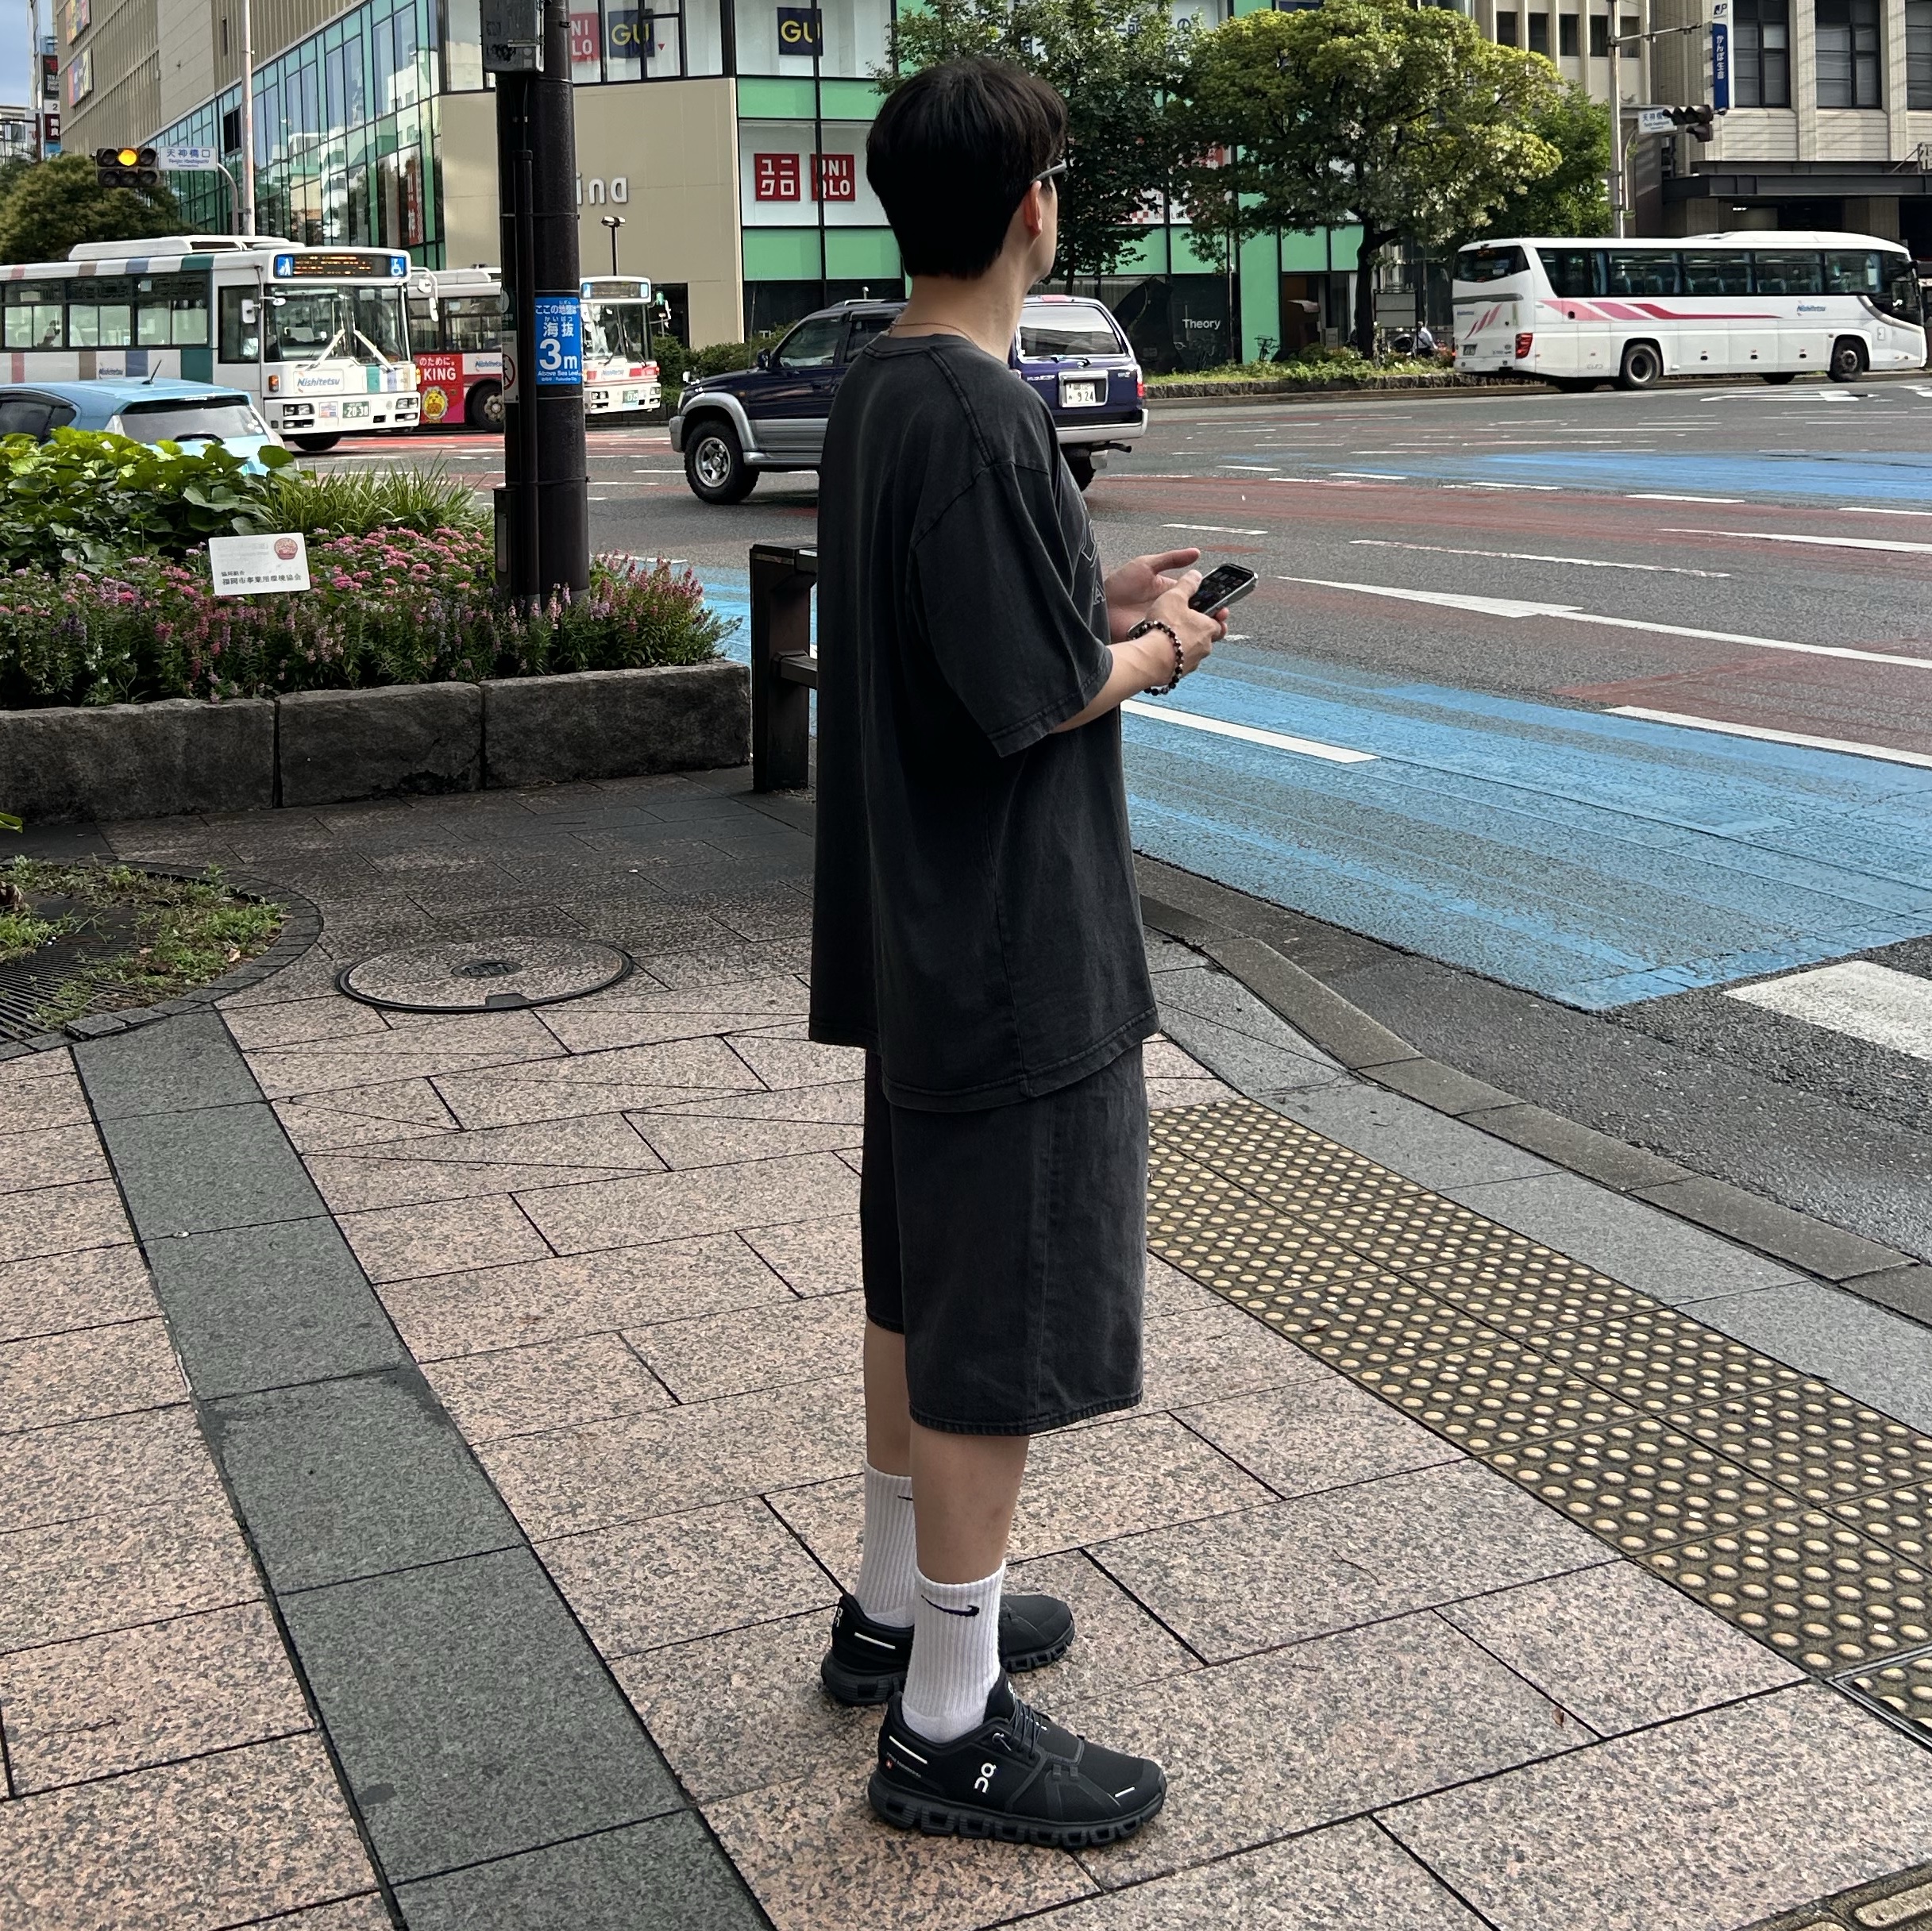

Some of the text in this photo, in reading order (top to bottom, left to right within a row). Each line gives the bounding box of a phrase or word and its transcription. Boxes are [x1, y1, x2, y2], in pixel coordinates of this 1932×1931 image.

[570, 20, 589, 37] NI
[611, 23, 650, 46] GU
[781, 20, 821, 44] GU
[570, 39, 593, 56] LO
[166, 148, 210, 158] 天神橋口
[761, 159, 794, 175] ユニ
[576, 172, 627, 205] ina
[760, 179, 795, 196] クロ
[543, 322, 574, 337] 海抜
[1182, 318, 1221, 330] Theory
[419, 357, 455, 366] のために。
[297, 377, 341, 387] Nishitetsu
[423, 368, 457, 381] KING
